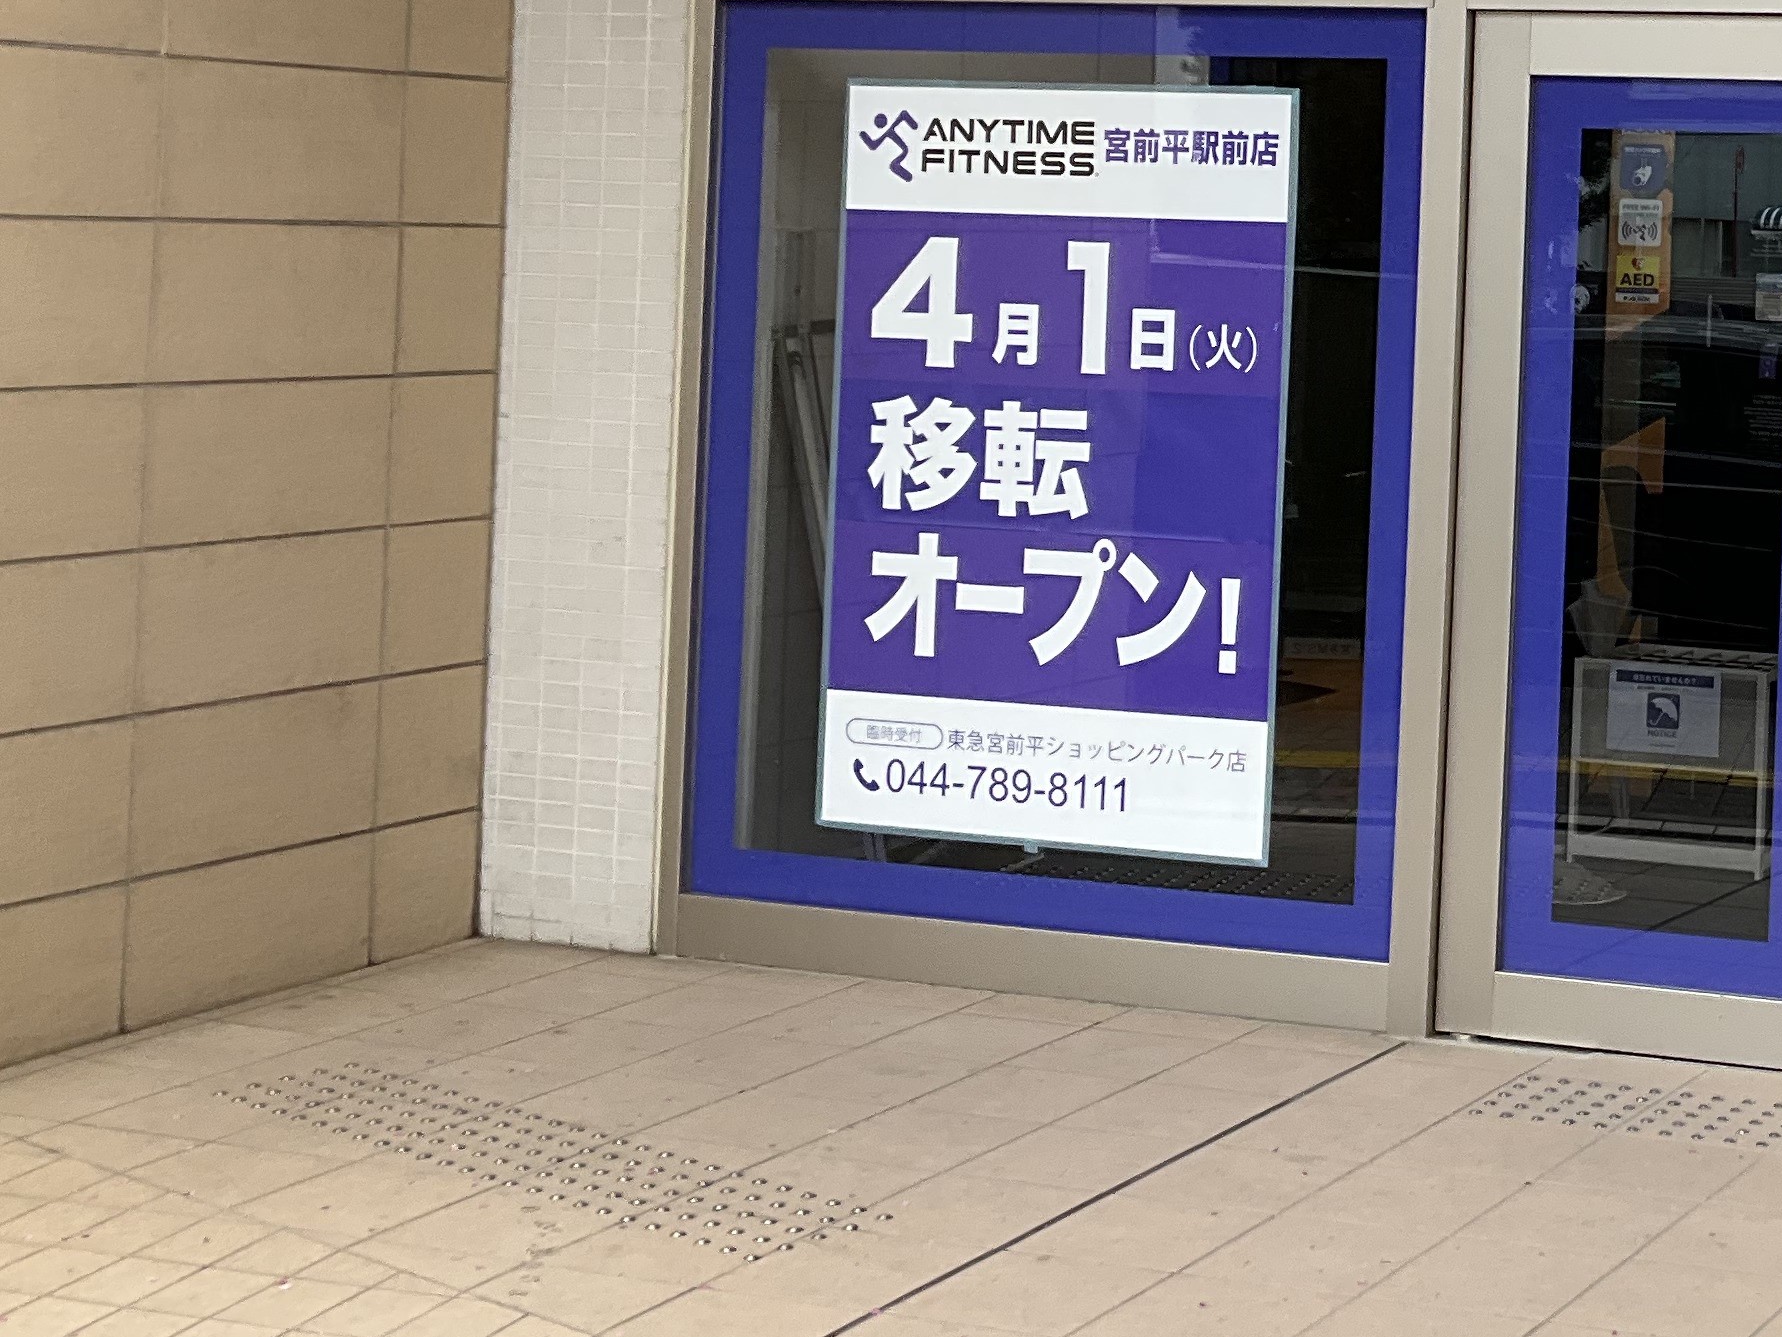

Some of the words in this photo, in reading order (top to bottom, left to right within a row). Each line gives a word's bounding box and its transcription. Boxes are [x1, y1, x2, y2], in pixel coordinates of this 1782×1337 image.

[922, 117, 1096, 145] ANYTIME
[1103, 126, 1280, 167] 宮前平駅前店
[920, 148, 1097, 177] FITNESS
[1620, 272, 1655, 286] AED
[867, 394, 1092, 520] 移転
[863, 532, 1242, 675] オープン!
[865, 724, 922, 745] 臨時受付
[947, 729, 1248, 773] 東急宮前平ショッピングパーク店
[886, 758, 1129, 812] 044-789-8111
